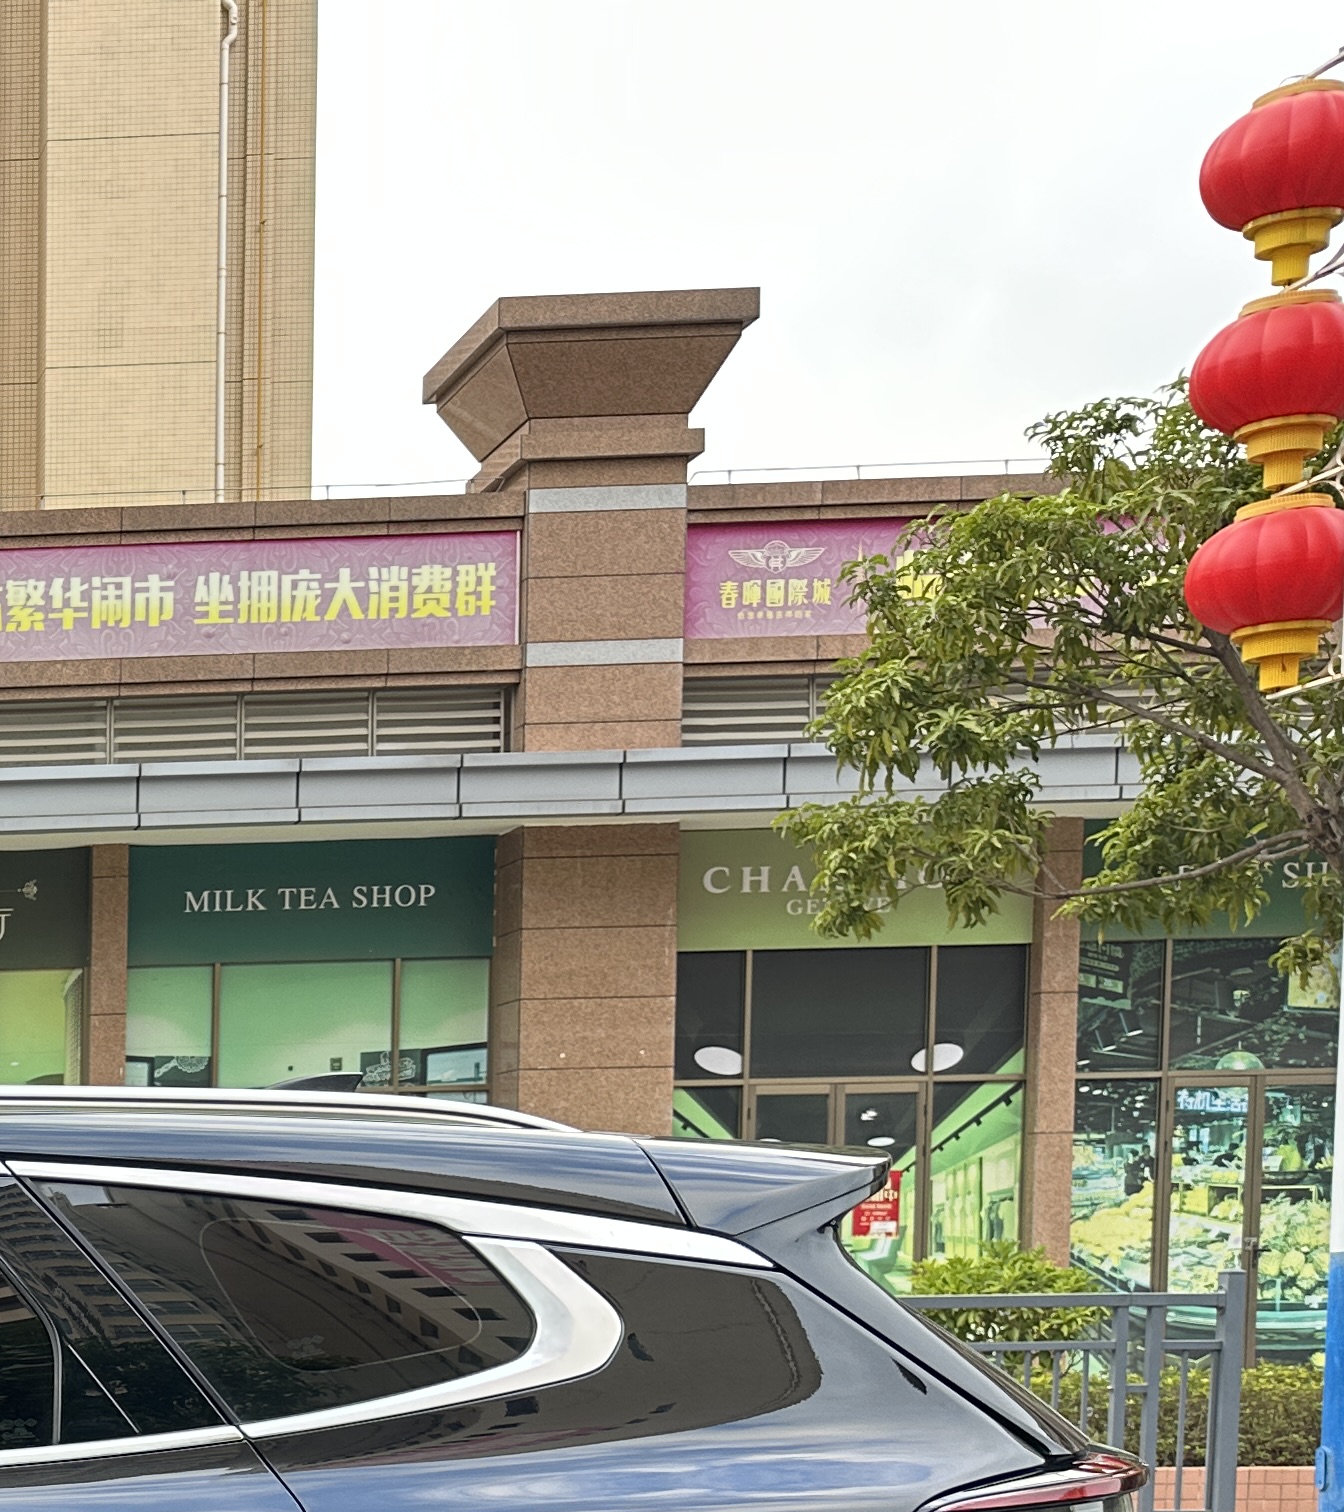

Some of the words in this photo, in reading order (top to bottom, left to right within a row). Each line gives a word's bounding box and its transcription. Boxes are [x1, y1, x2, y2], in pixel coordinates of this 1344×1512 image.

[193, 562, 497, 627] 坐拥庞大消费群
[184, 889, 267, 912] MILK
[277, 887, 340, 910] TEA
[352, 884, 436, 909] SHOP
